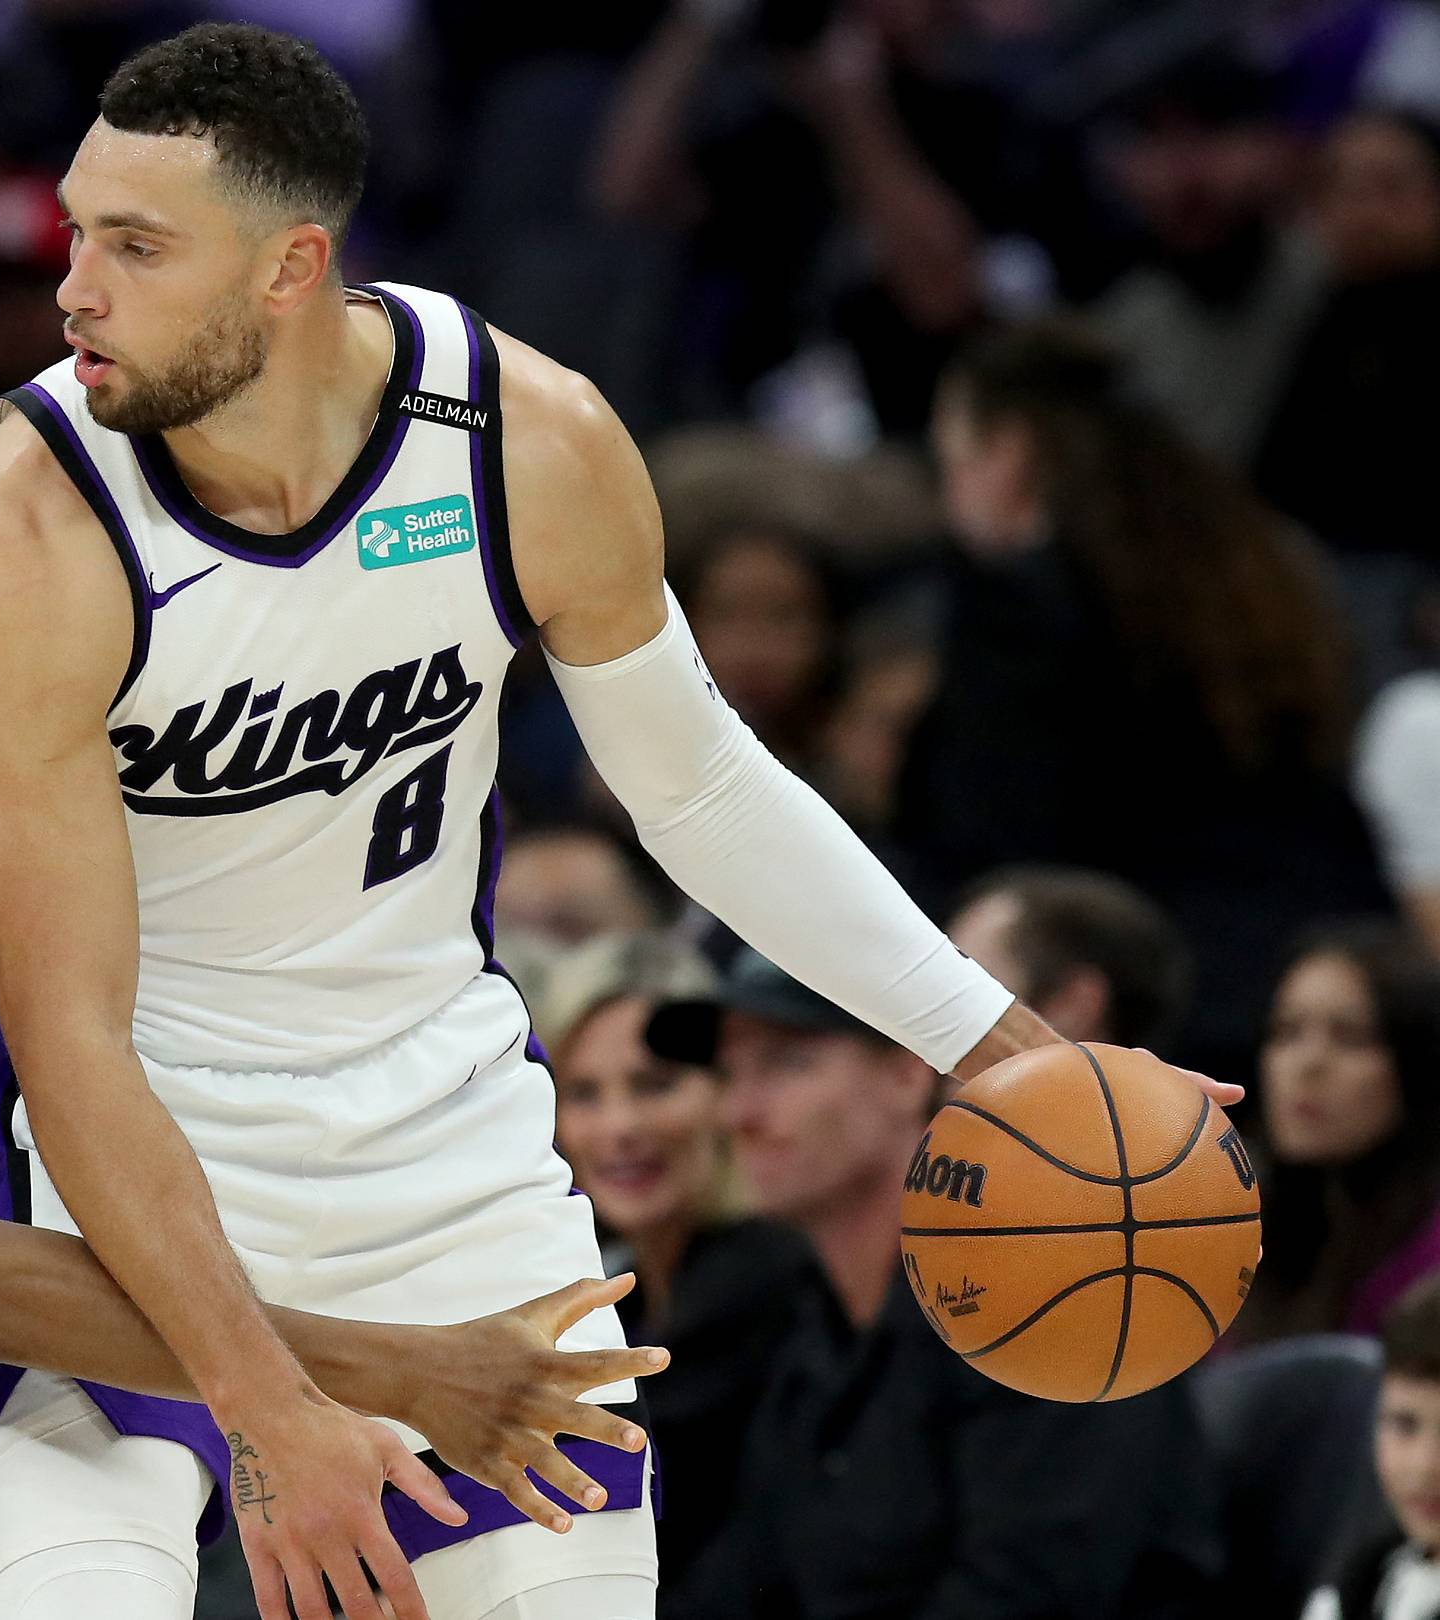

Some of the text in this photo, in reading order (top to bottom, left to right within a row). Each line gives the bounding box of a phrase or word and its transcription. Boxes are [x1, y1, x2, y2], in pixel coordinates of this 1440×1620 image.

[398, 393, 488, 428] ADELMAN
[403, 507, 464, 533] Sutter
[406, 525, 470, 553] Health
[108, 642, 483, 817] Kings
[362, 740, 454, 892] 8
[902, 1130, 988, 1209] lson
